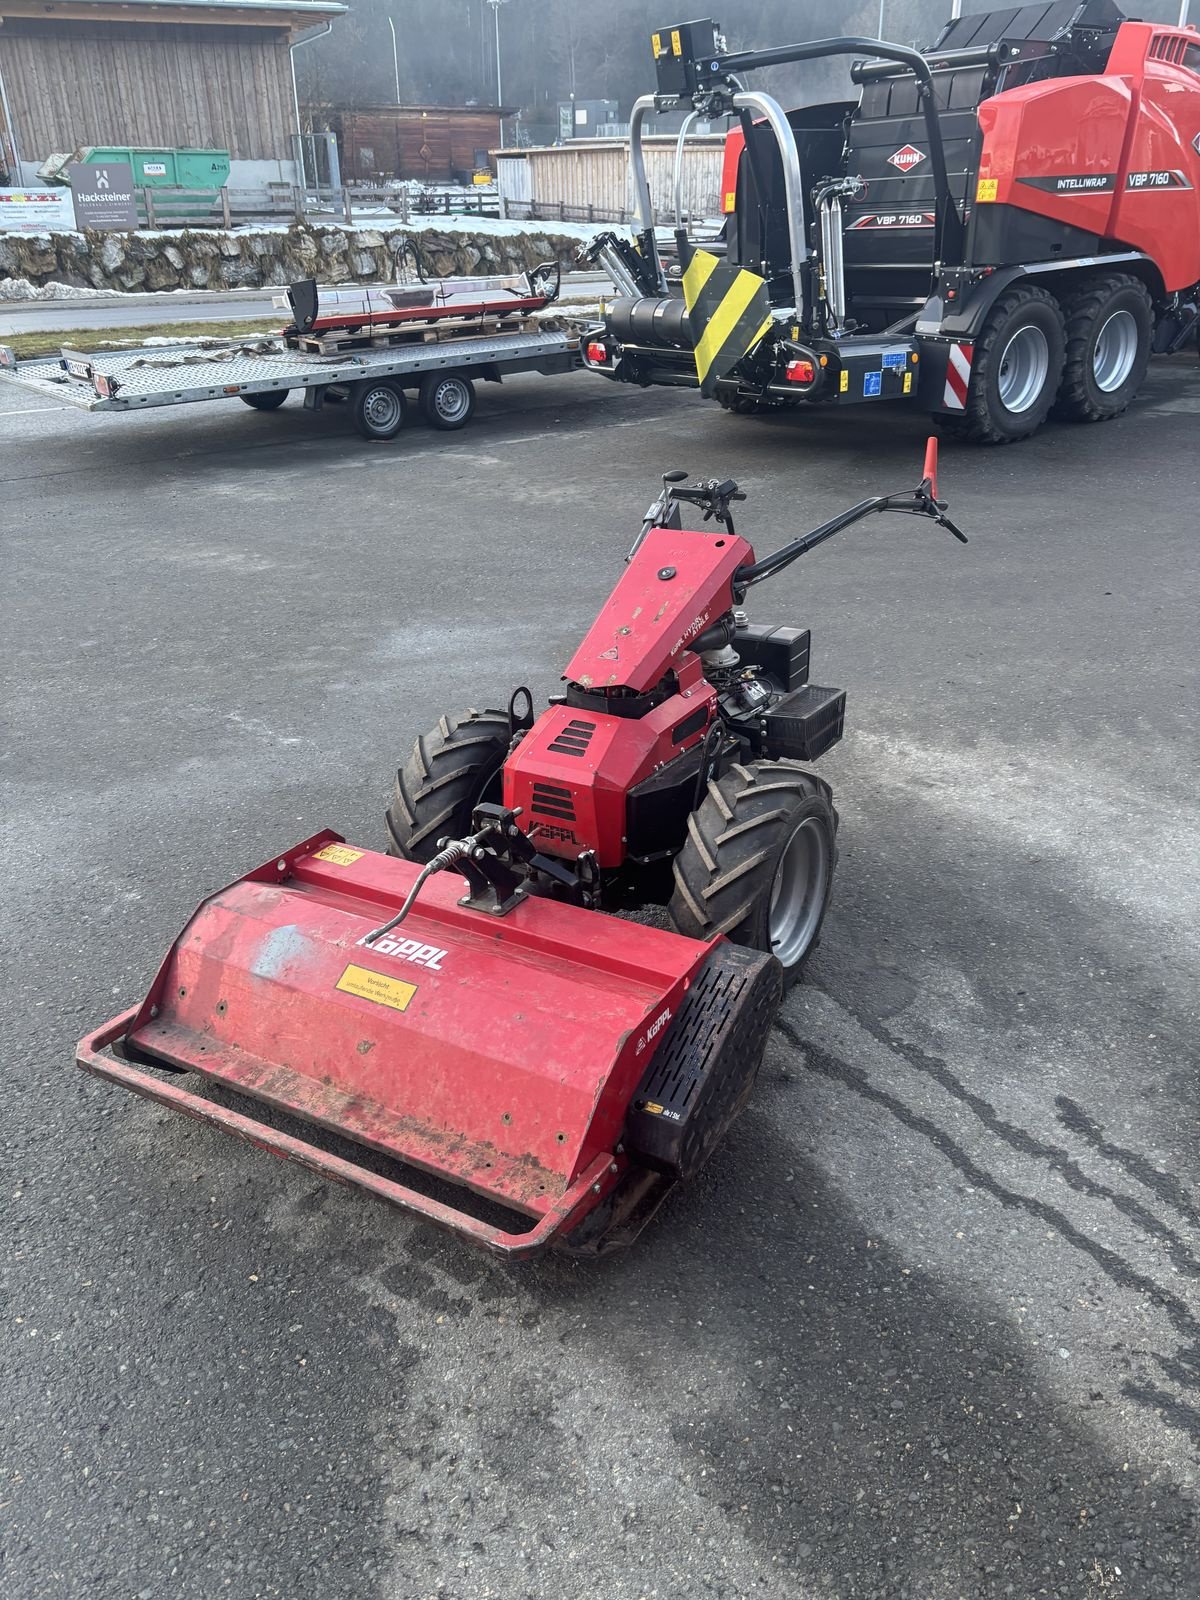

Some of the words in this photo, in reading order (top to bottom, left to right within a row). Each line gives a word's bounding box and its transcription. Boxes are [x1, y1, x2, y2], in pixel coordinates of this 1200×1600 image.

[893, 152, 920, 164] KUHN
[1057, 177, 1107, 189] INTELLIWRAP
[1128, 173, 1148, 187] VBP
[1149, 172, 1170, 185] 7160
[77, 192, 131, 202] Hacksteiner
[876, 215, 897, 225] VBP
[898, 214, 922, 224] 7160
[367, 977, 390, 990] Vorsicht
